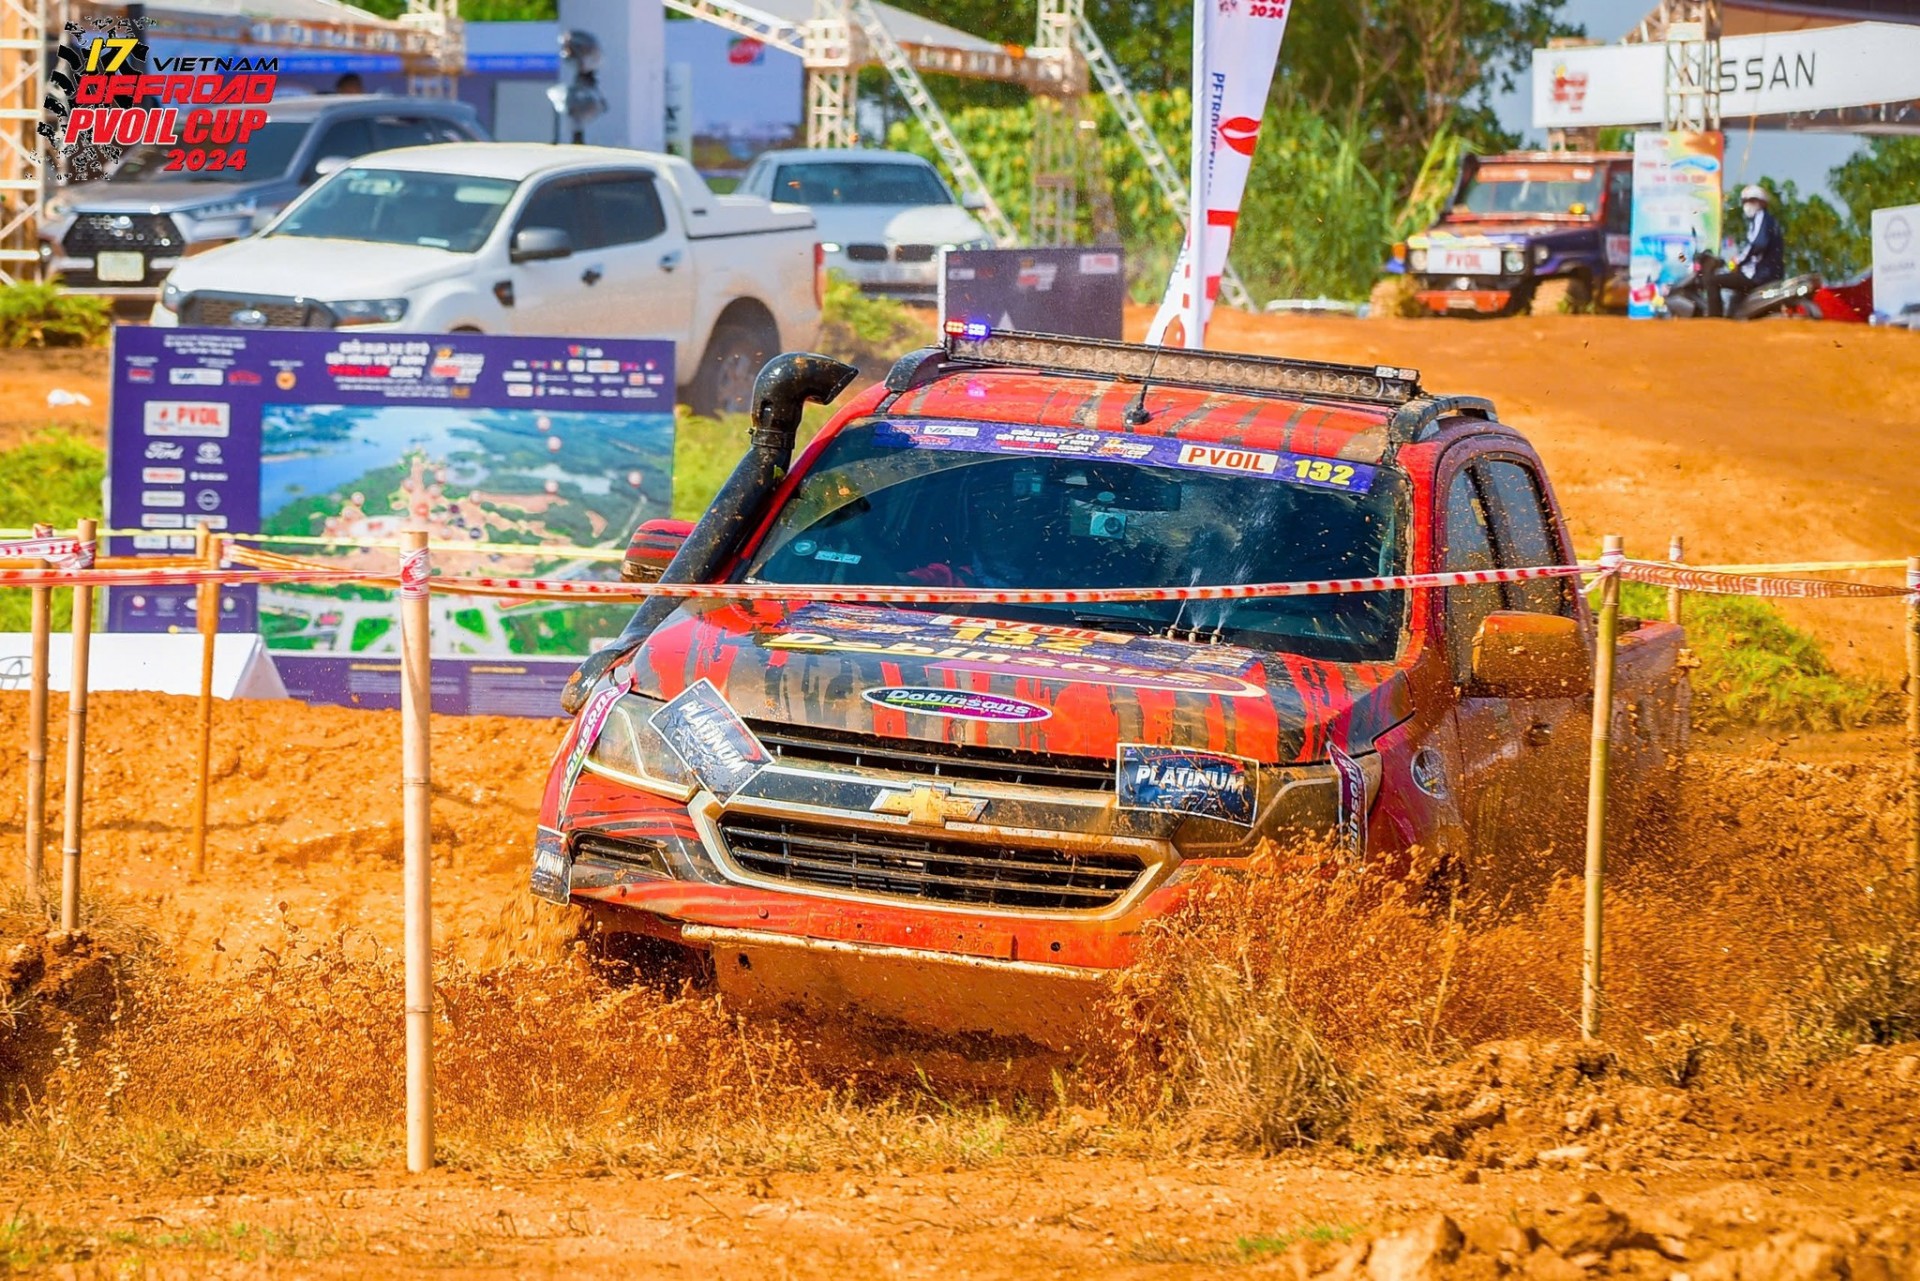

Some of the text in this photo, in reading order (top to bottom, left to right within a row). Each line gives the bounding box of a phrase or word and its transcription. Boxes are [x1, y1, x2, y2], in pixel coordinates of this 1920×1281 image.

[1249, 4, 1284, 19] 2024
[1188, 446, 1355, 486] PVOIL 132
[952, 627, 1094, 653] 132
[769, 632, 1211, 684] Dobinsons
[886, 690, 1031, 715] Dobinsons
[678, 699, 751, 775] PLATINUM
[1135, 764, 1246, 795] PLATINUM
